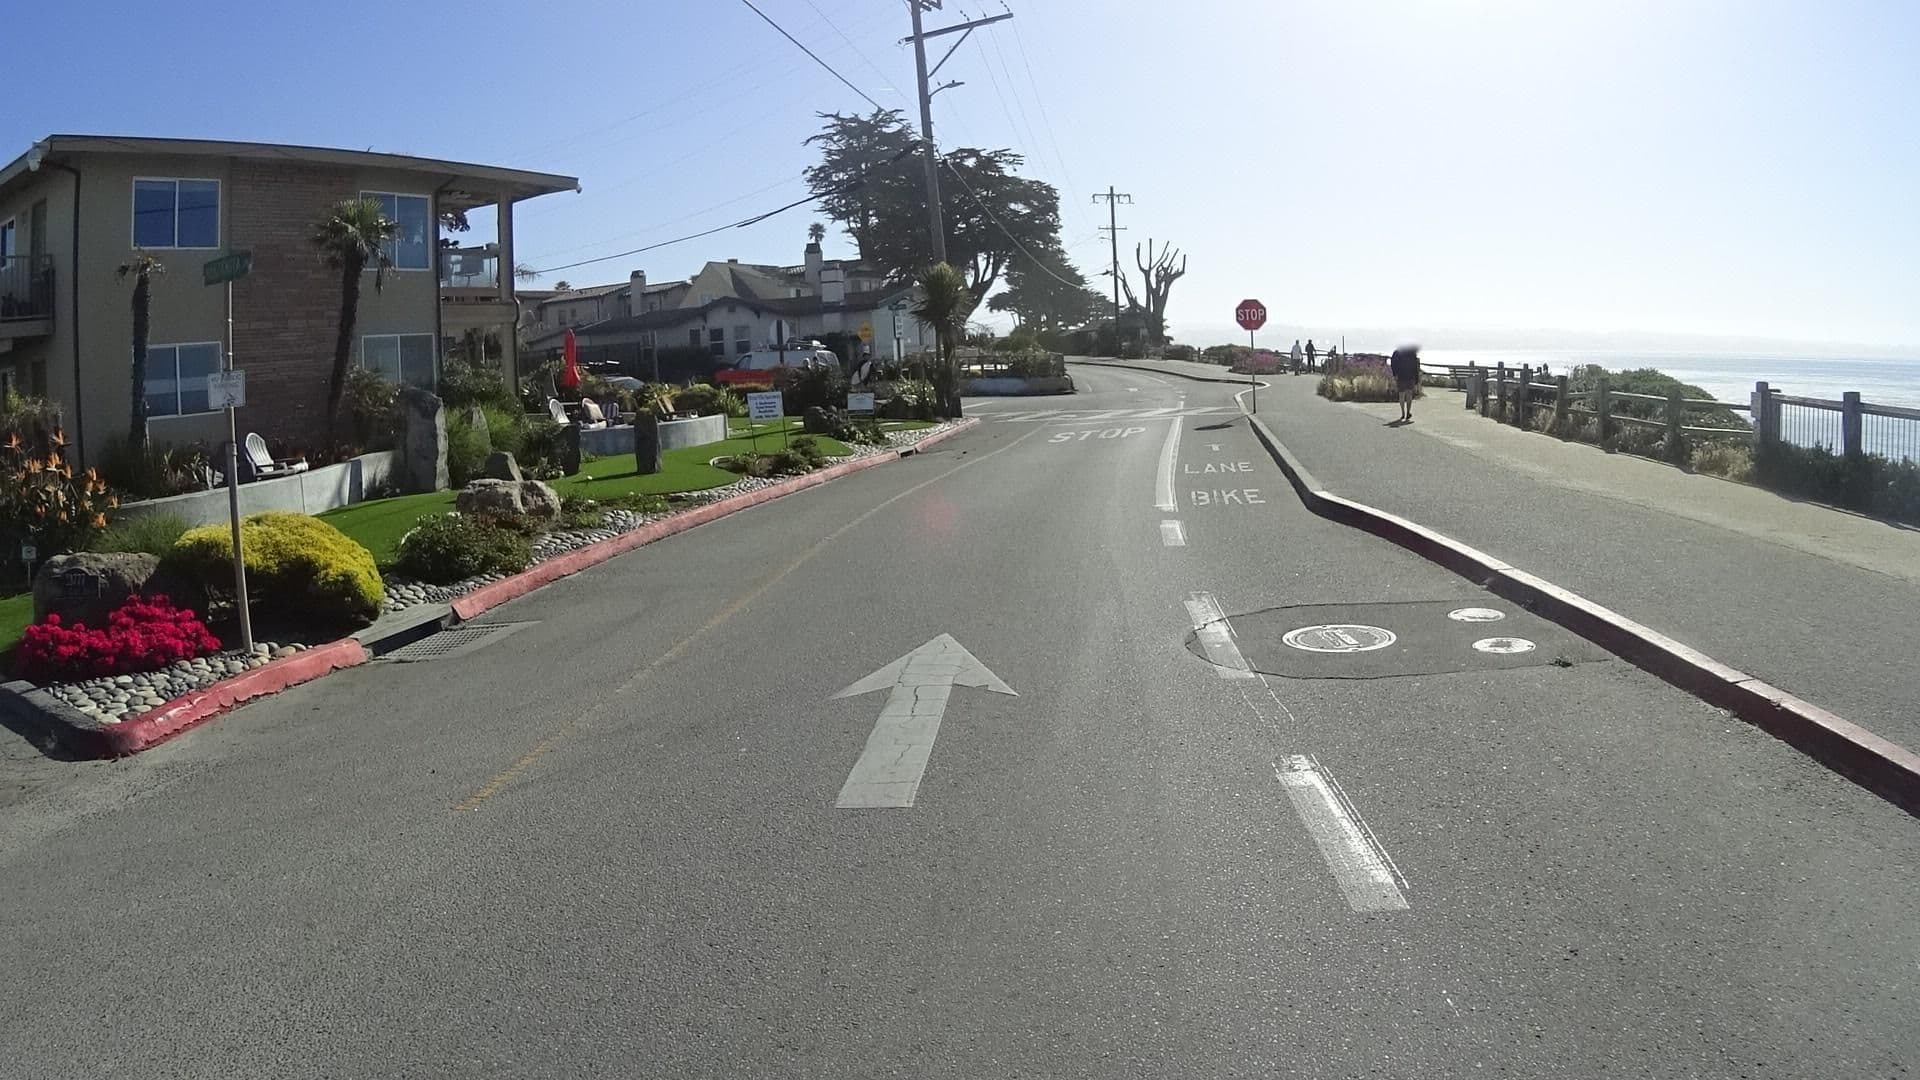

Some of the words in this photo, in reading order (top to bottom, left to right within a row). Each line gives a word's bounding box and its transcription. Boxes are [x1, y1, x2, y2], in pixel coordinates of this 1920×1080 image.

[1238, 308, 1264, 320] STOP
[1048, 427, 1146, 443] STOP
[1184, 461, 1255, 475] LANE
[1191, 488, 1267, 506] BIKE
